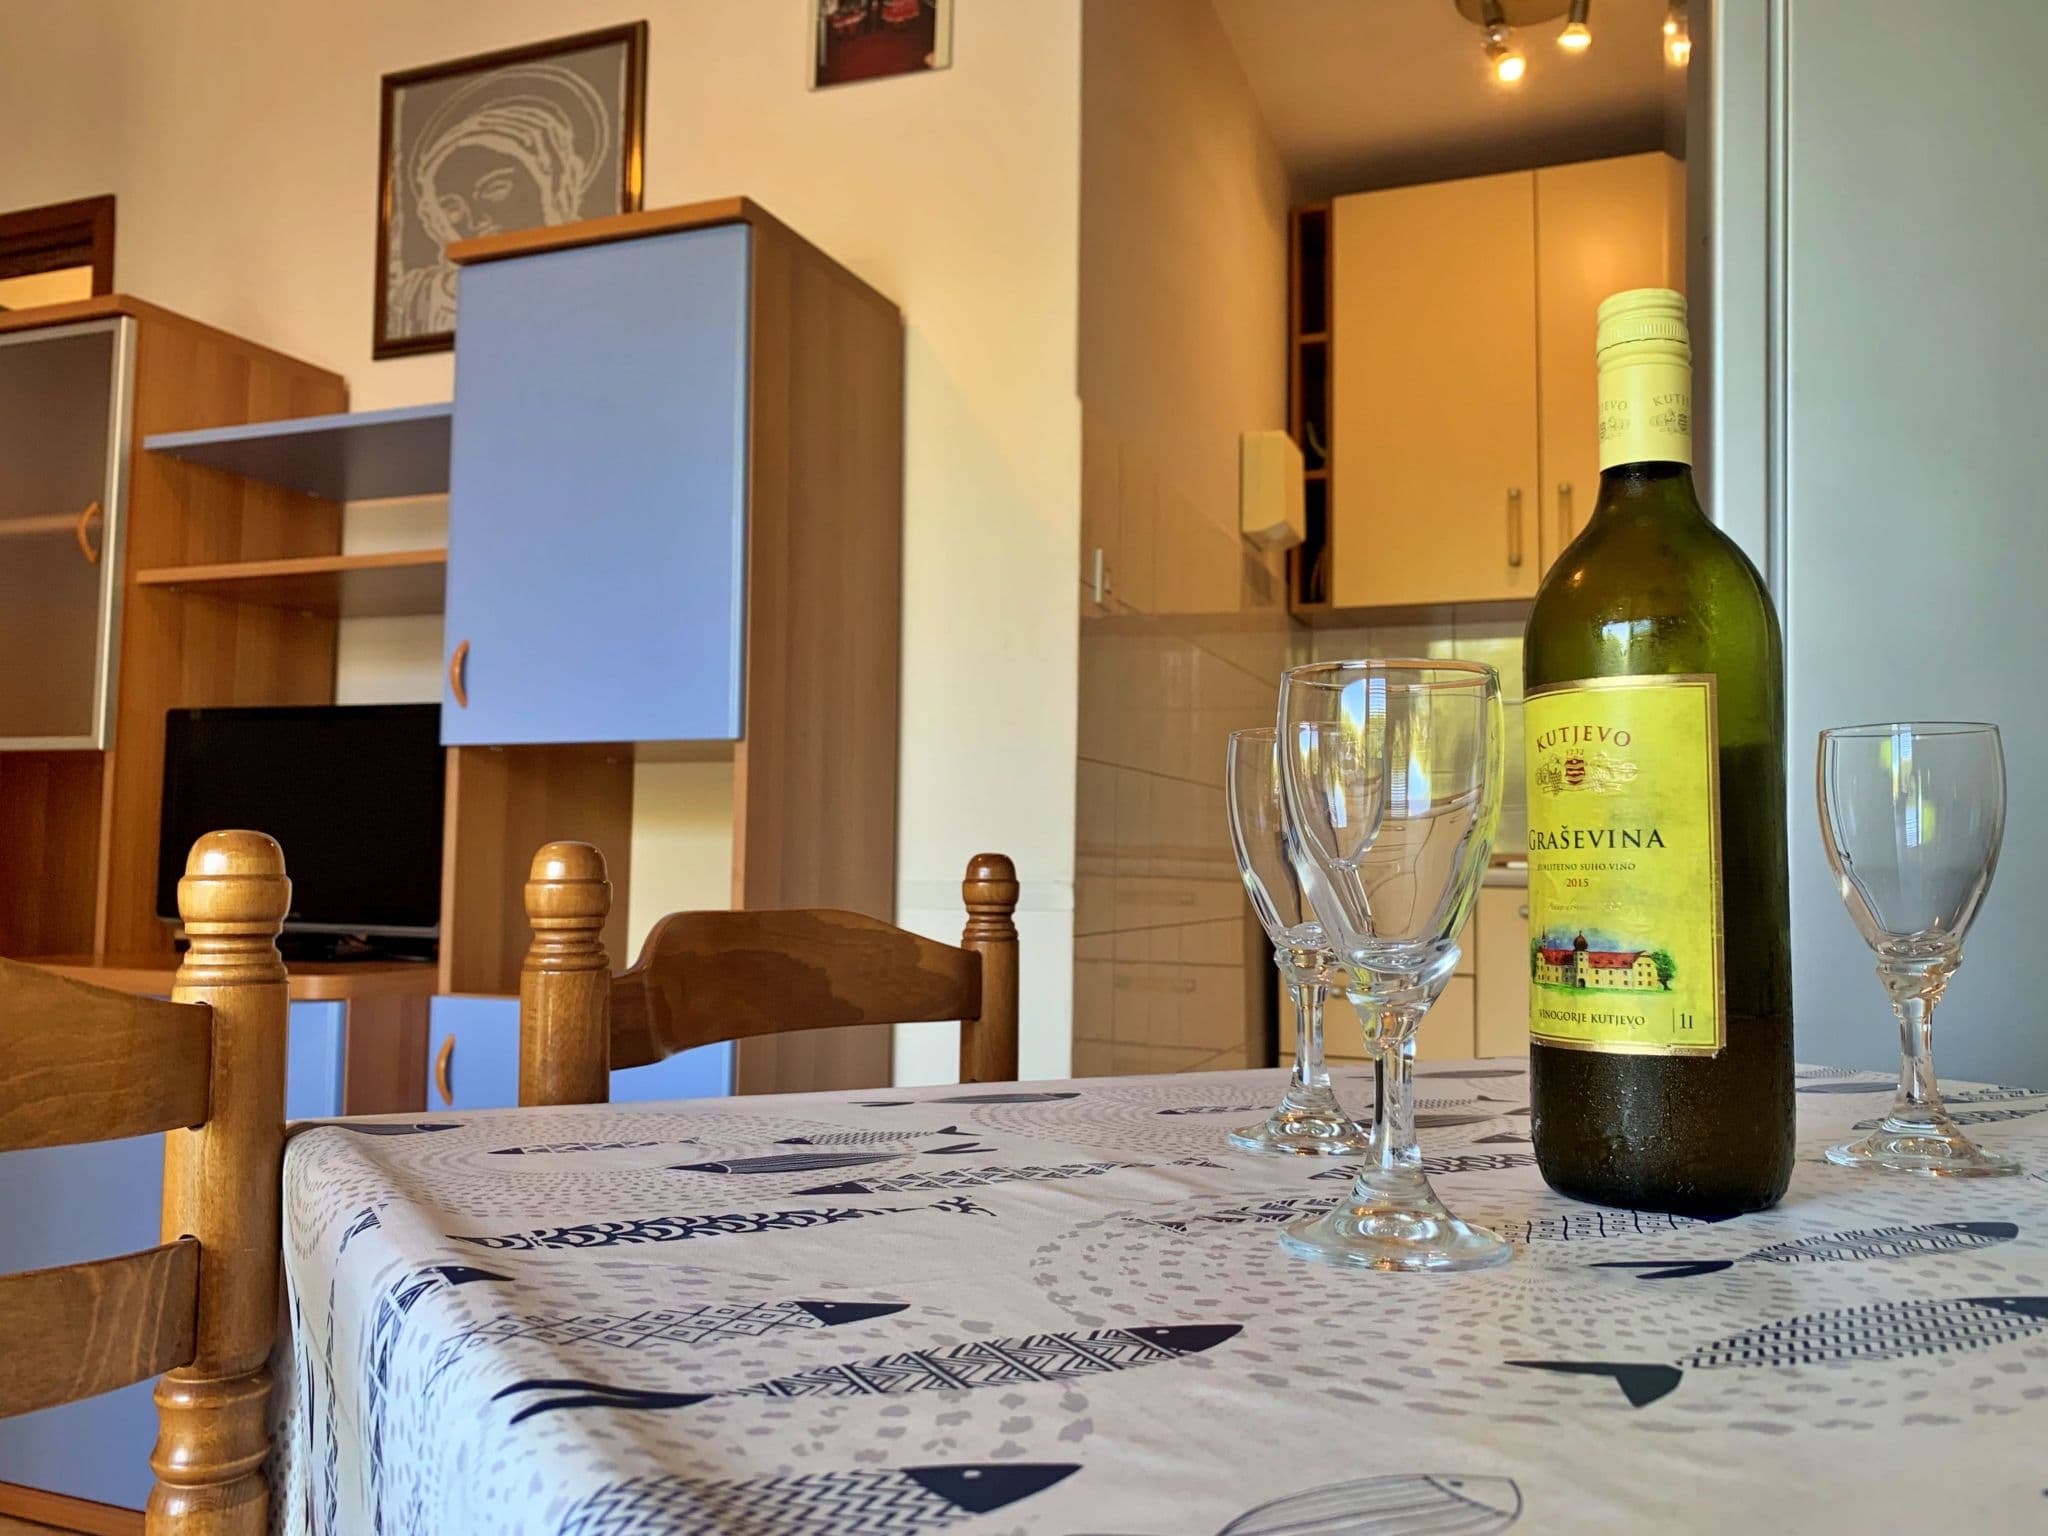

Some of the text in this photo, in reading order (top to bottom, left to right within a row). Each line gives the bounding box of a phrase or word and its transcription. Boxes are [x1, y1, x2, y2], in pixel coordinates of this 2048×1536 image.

[1536, 725, 1631, 753] KUTJEVO
[1528, 825, 1667, 851] GRAŠEVINA
[1579, 863, 1606, 871] SUHO
[1608, 863, 1636, 871] VINO
[1566, 878, 1590, 888] 2015
[1538, 1008, 1646, 1027] VINOGORJE KUTJEVO
